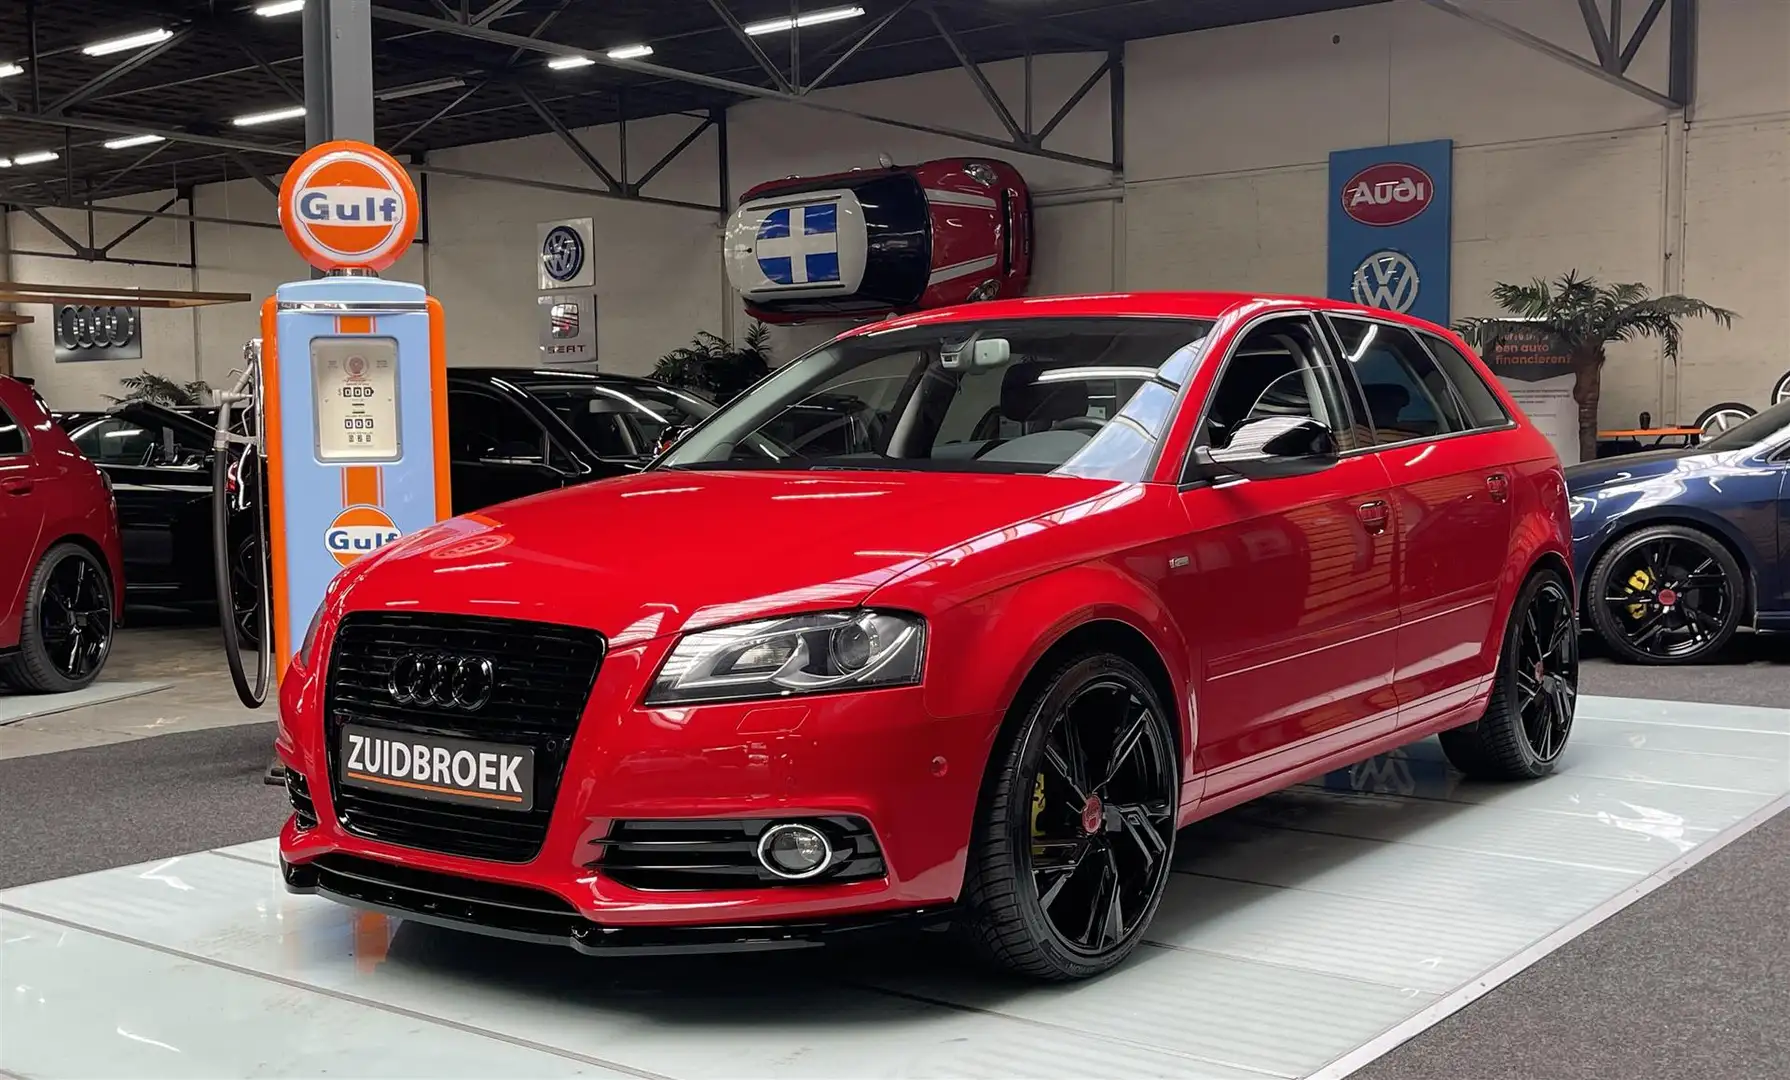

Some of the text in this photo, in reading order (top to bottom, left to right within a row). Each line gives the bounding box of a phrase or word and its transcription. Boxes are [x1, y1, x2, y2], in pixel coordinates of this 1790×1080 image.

[300, 192, 397, 221] Gulf
[547, 344, 586, 354] SEAT
[1520, 343, 1550, 353] auto
[347, 734, 523, 793] ZUIDBROEK
